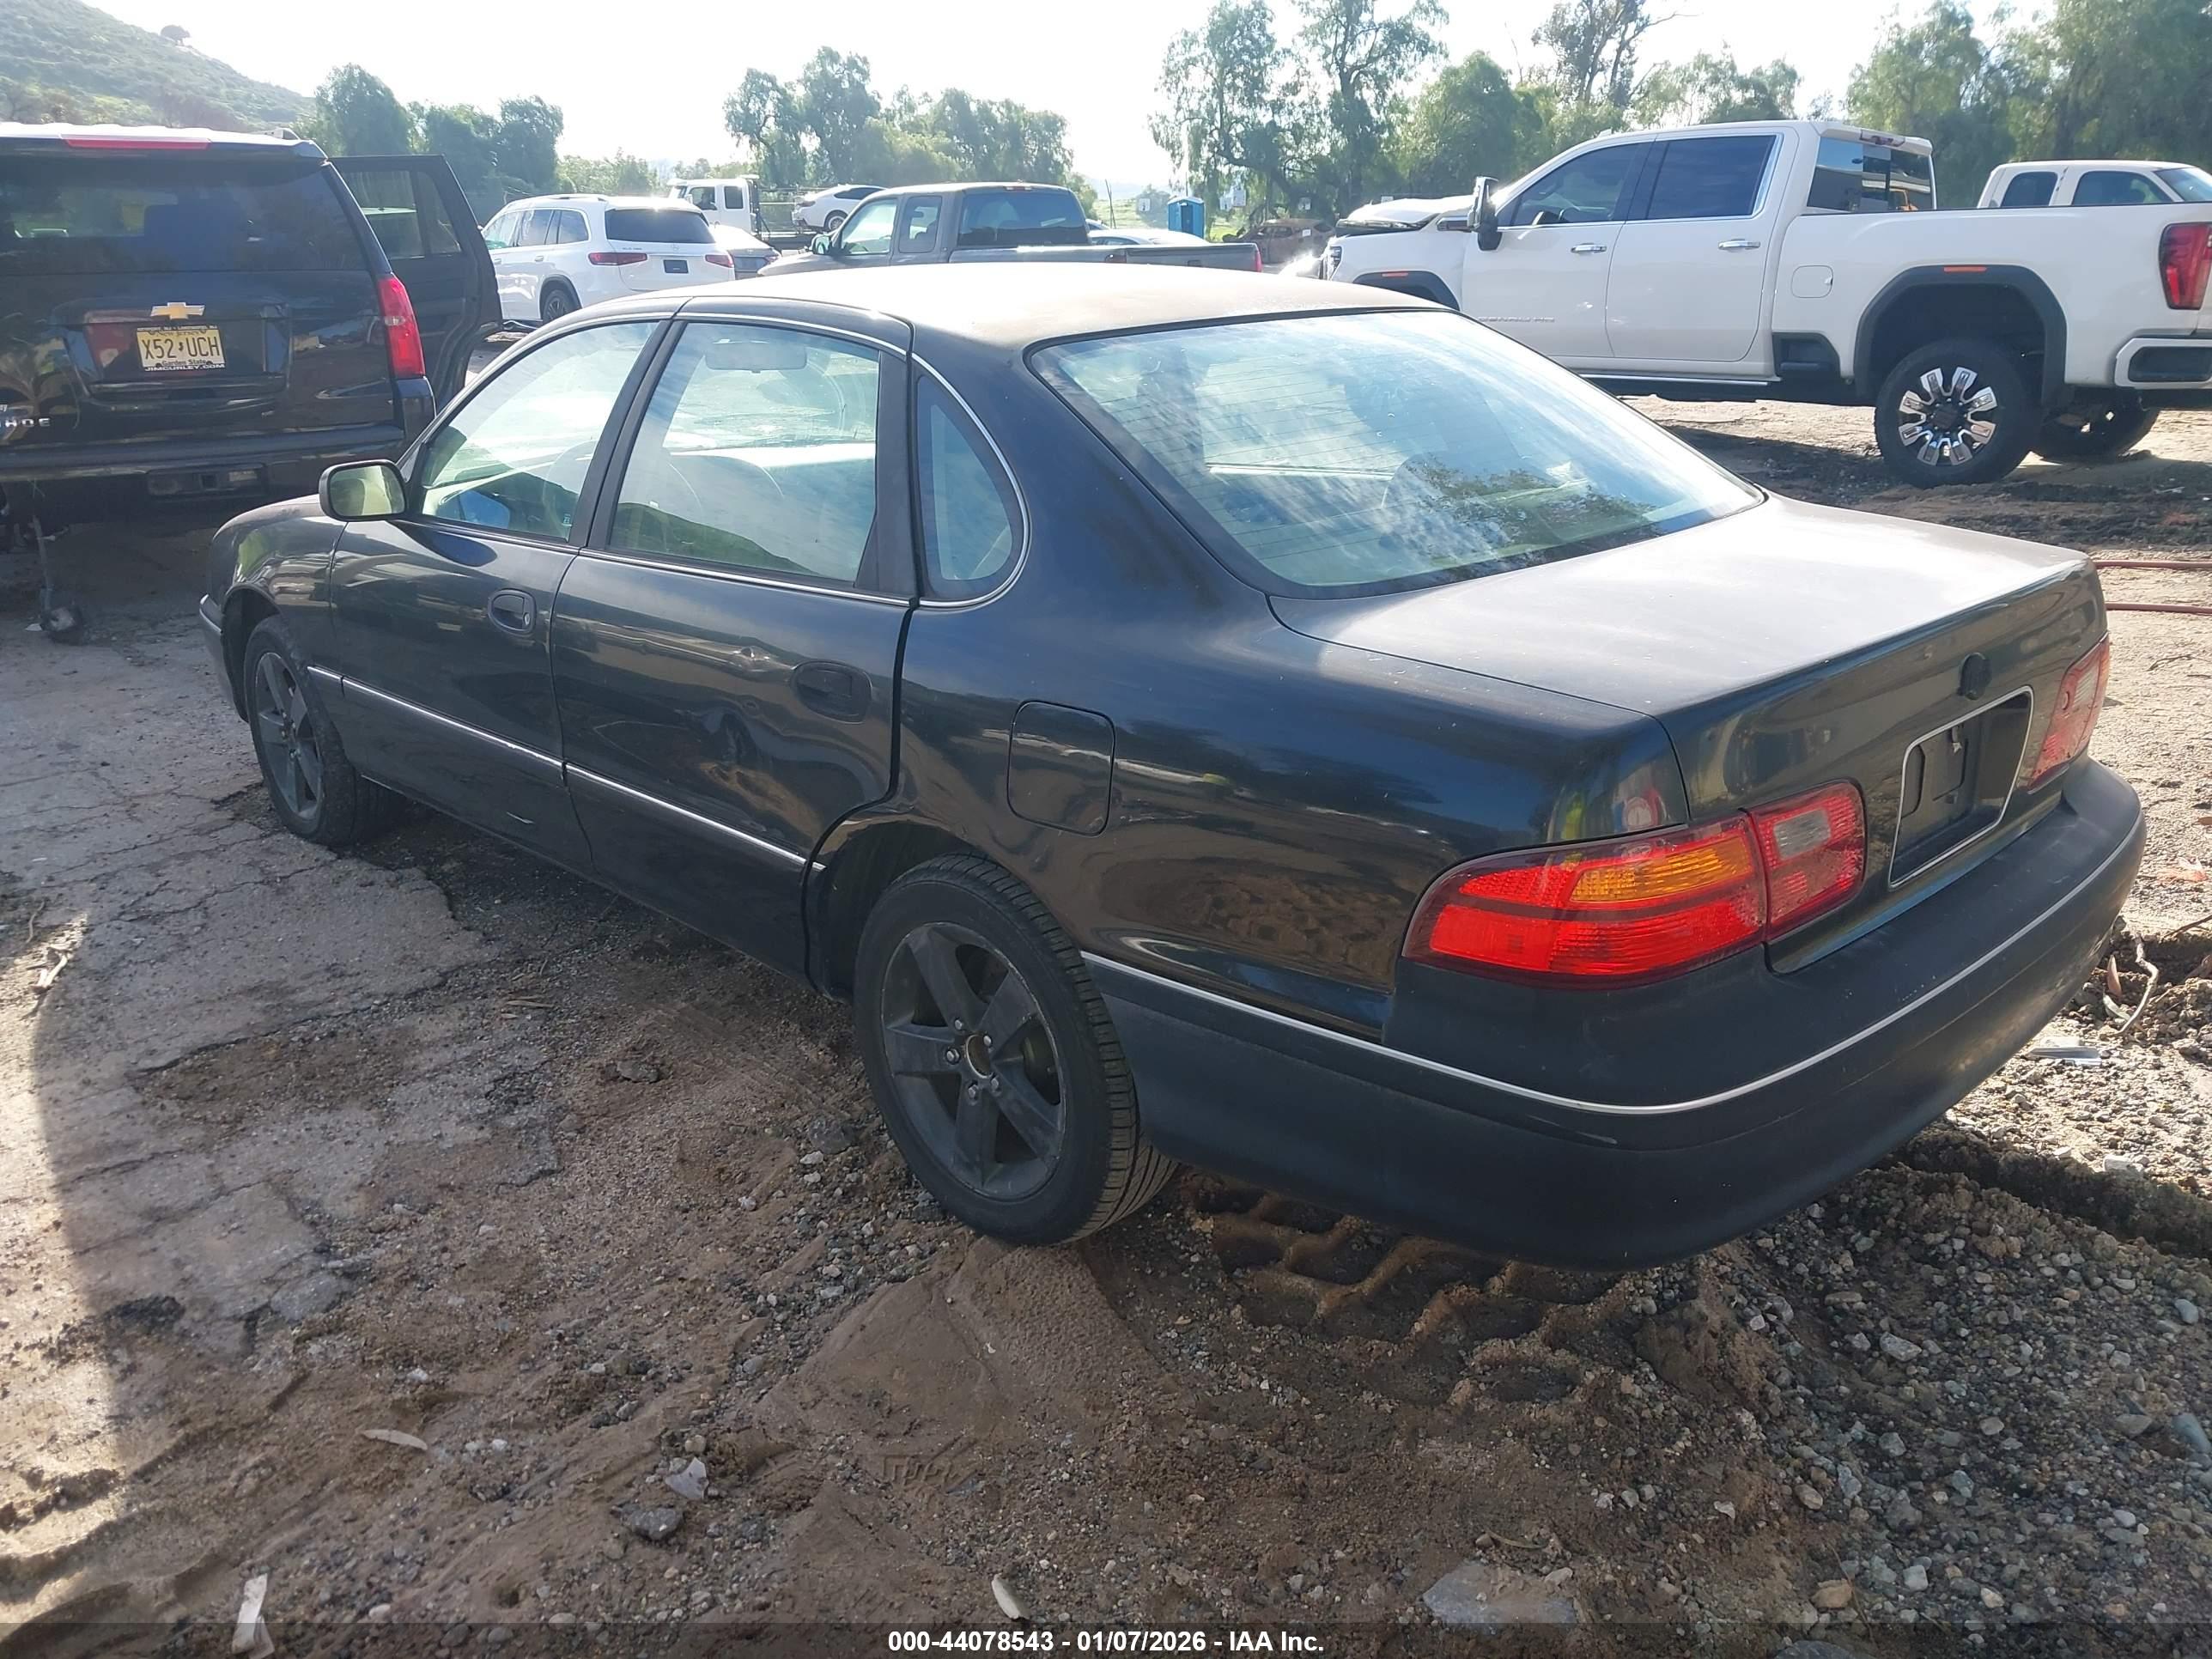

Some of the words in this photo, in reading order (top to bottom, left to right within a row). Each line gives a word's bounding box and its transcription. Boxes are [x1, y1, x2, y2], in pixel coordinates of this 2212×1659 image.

[142, 338, 177, 360] X52
[185, 337, 220, 357] UCH
[0, 417, 51, 428] HOE
